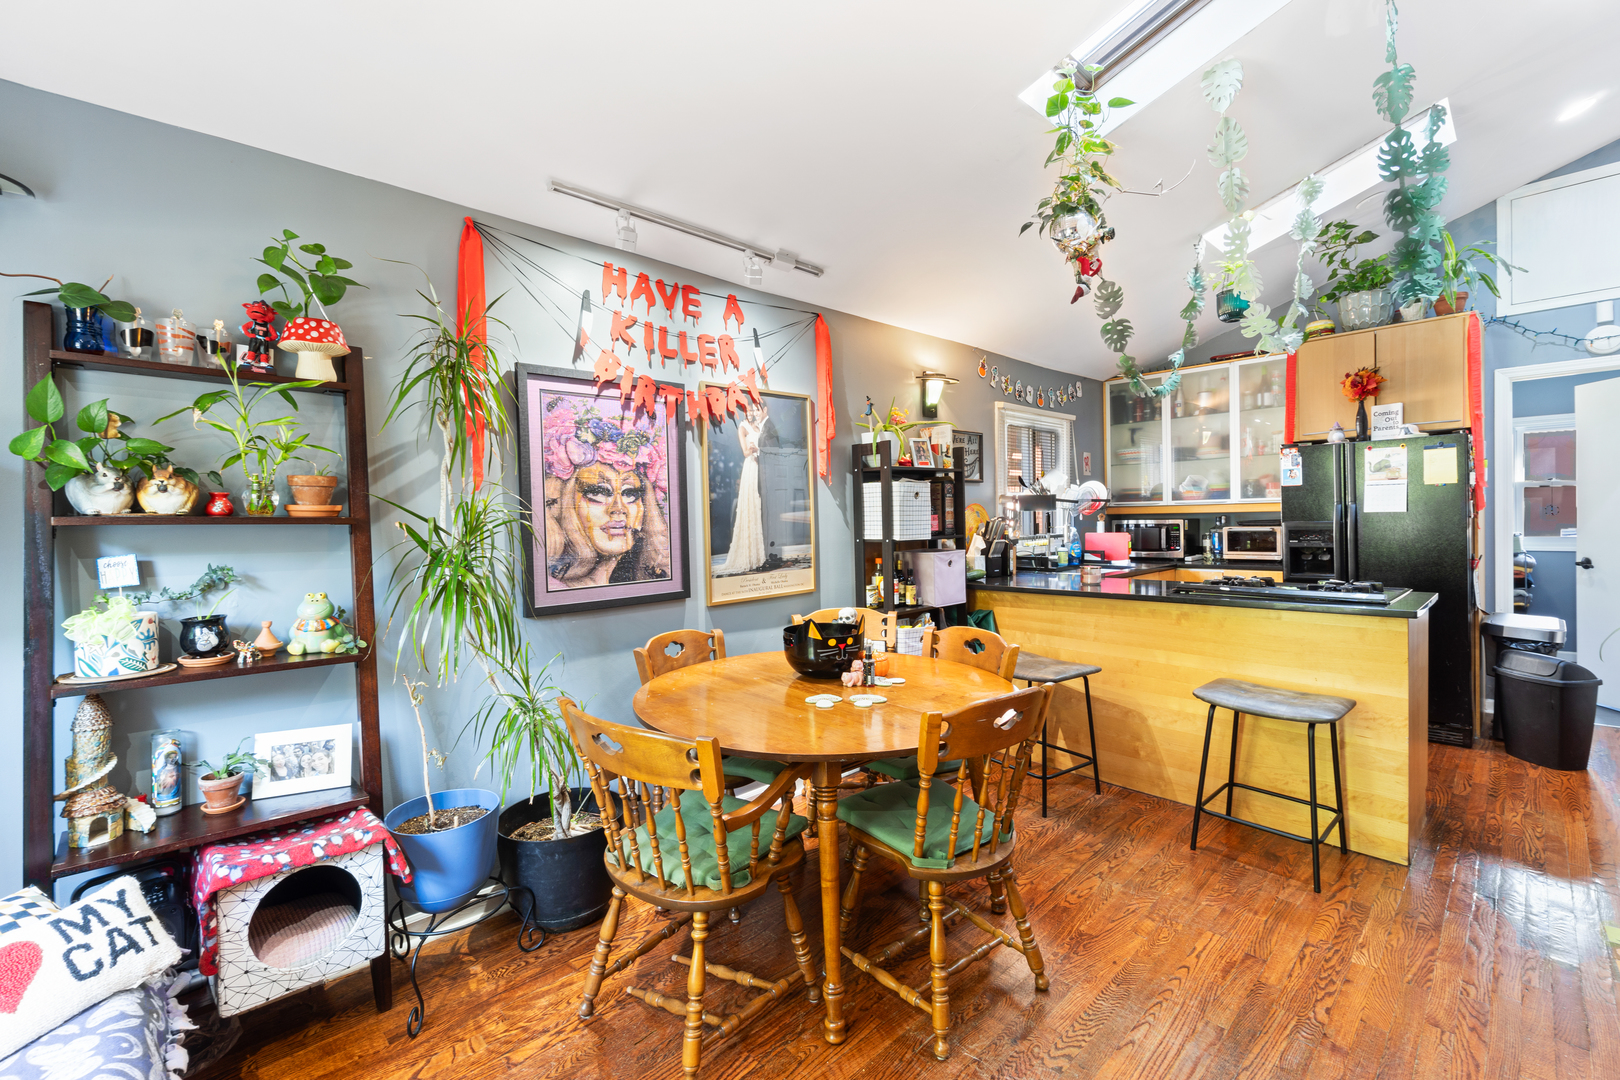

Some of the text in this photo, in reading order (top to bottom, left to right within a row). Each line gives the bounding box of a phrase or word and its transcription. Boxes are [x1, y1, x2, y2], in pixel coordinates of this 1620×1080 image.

[602, 261, 745, 334] HAVE A
[610, 310, 740, 375] KILLER
[593, 348, 764, 430] BIRTHDAY
[103, 559, 127, 569] choose
[47, 888, 135, 945] MY
[62, 915, 159, 981] CAT
